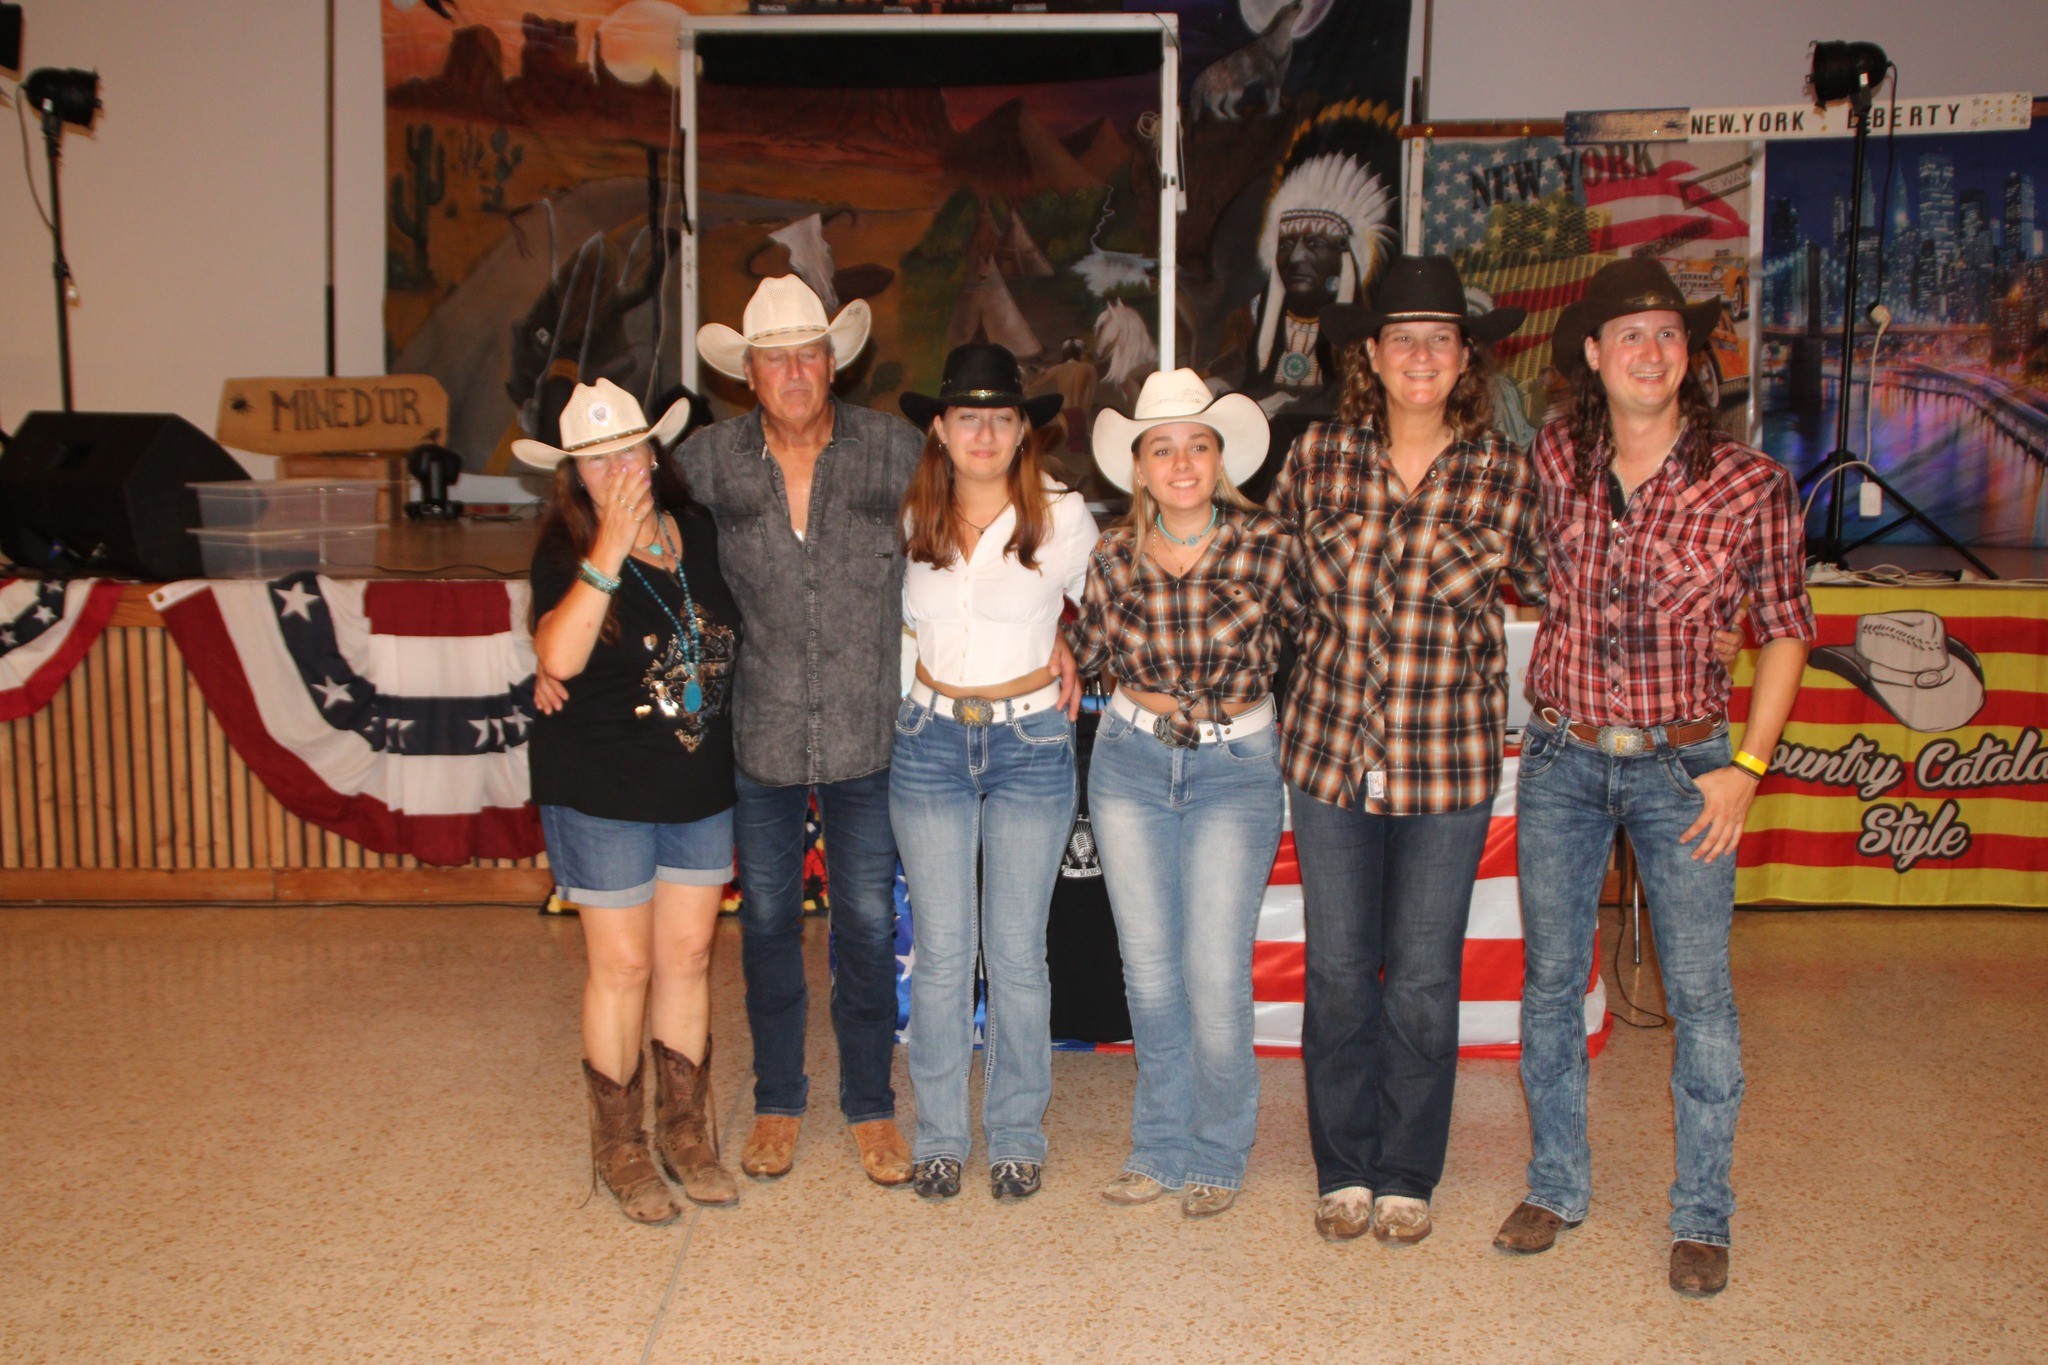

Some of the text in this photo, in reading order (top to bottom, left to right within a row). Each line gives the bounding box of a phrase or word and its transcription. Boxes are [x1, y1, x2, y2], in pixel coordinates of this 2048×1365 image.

[1846, 103, 1961, 130] LBERTY
[1469, 143, 1658, 210] NEW YORK
[1721, 169, 1748, 187] WAY
[1768, 735, 1904, 799] ountry
[1858, 801, 1970, 872] Style
